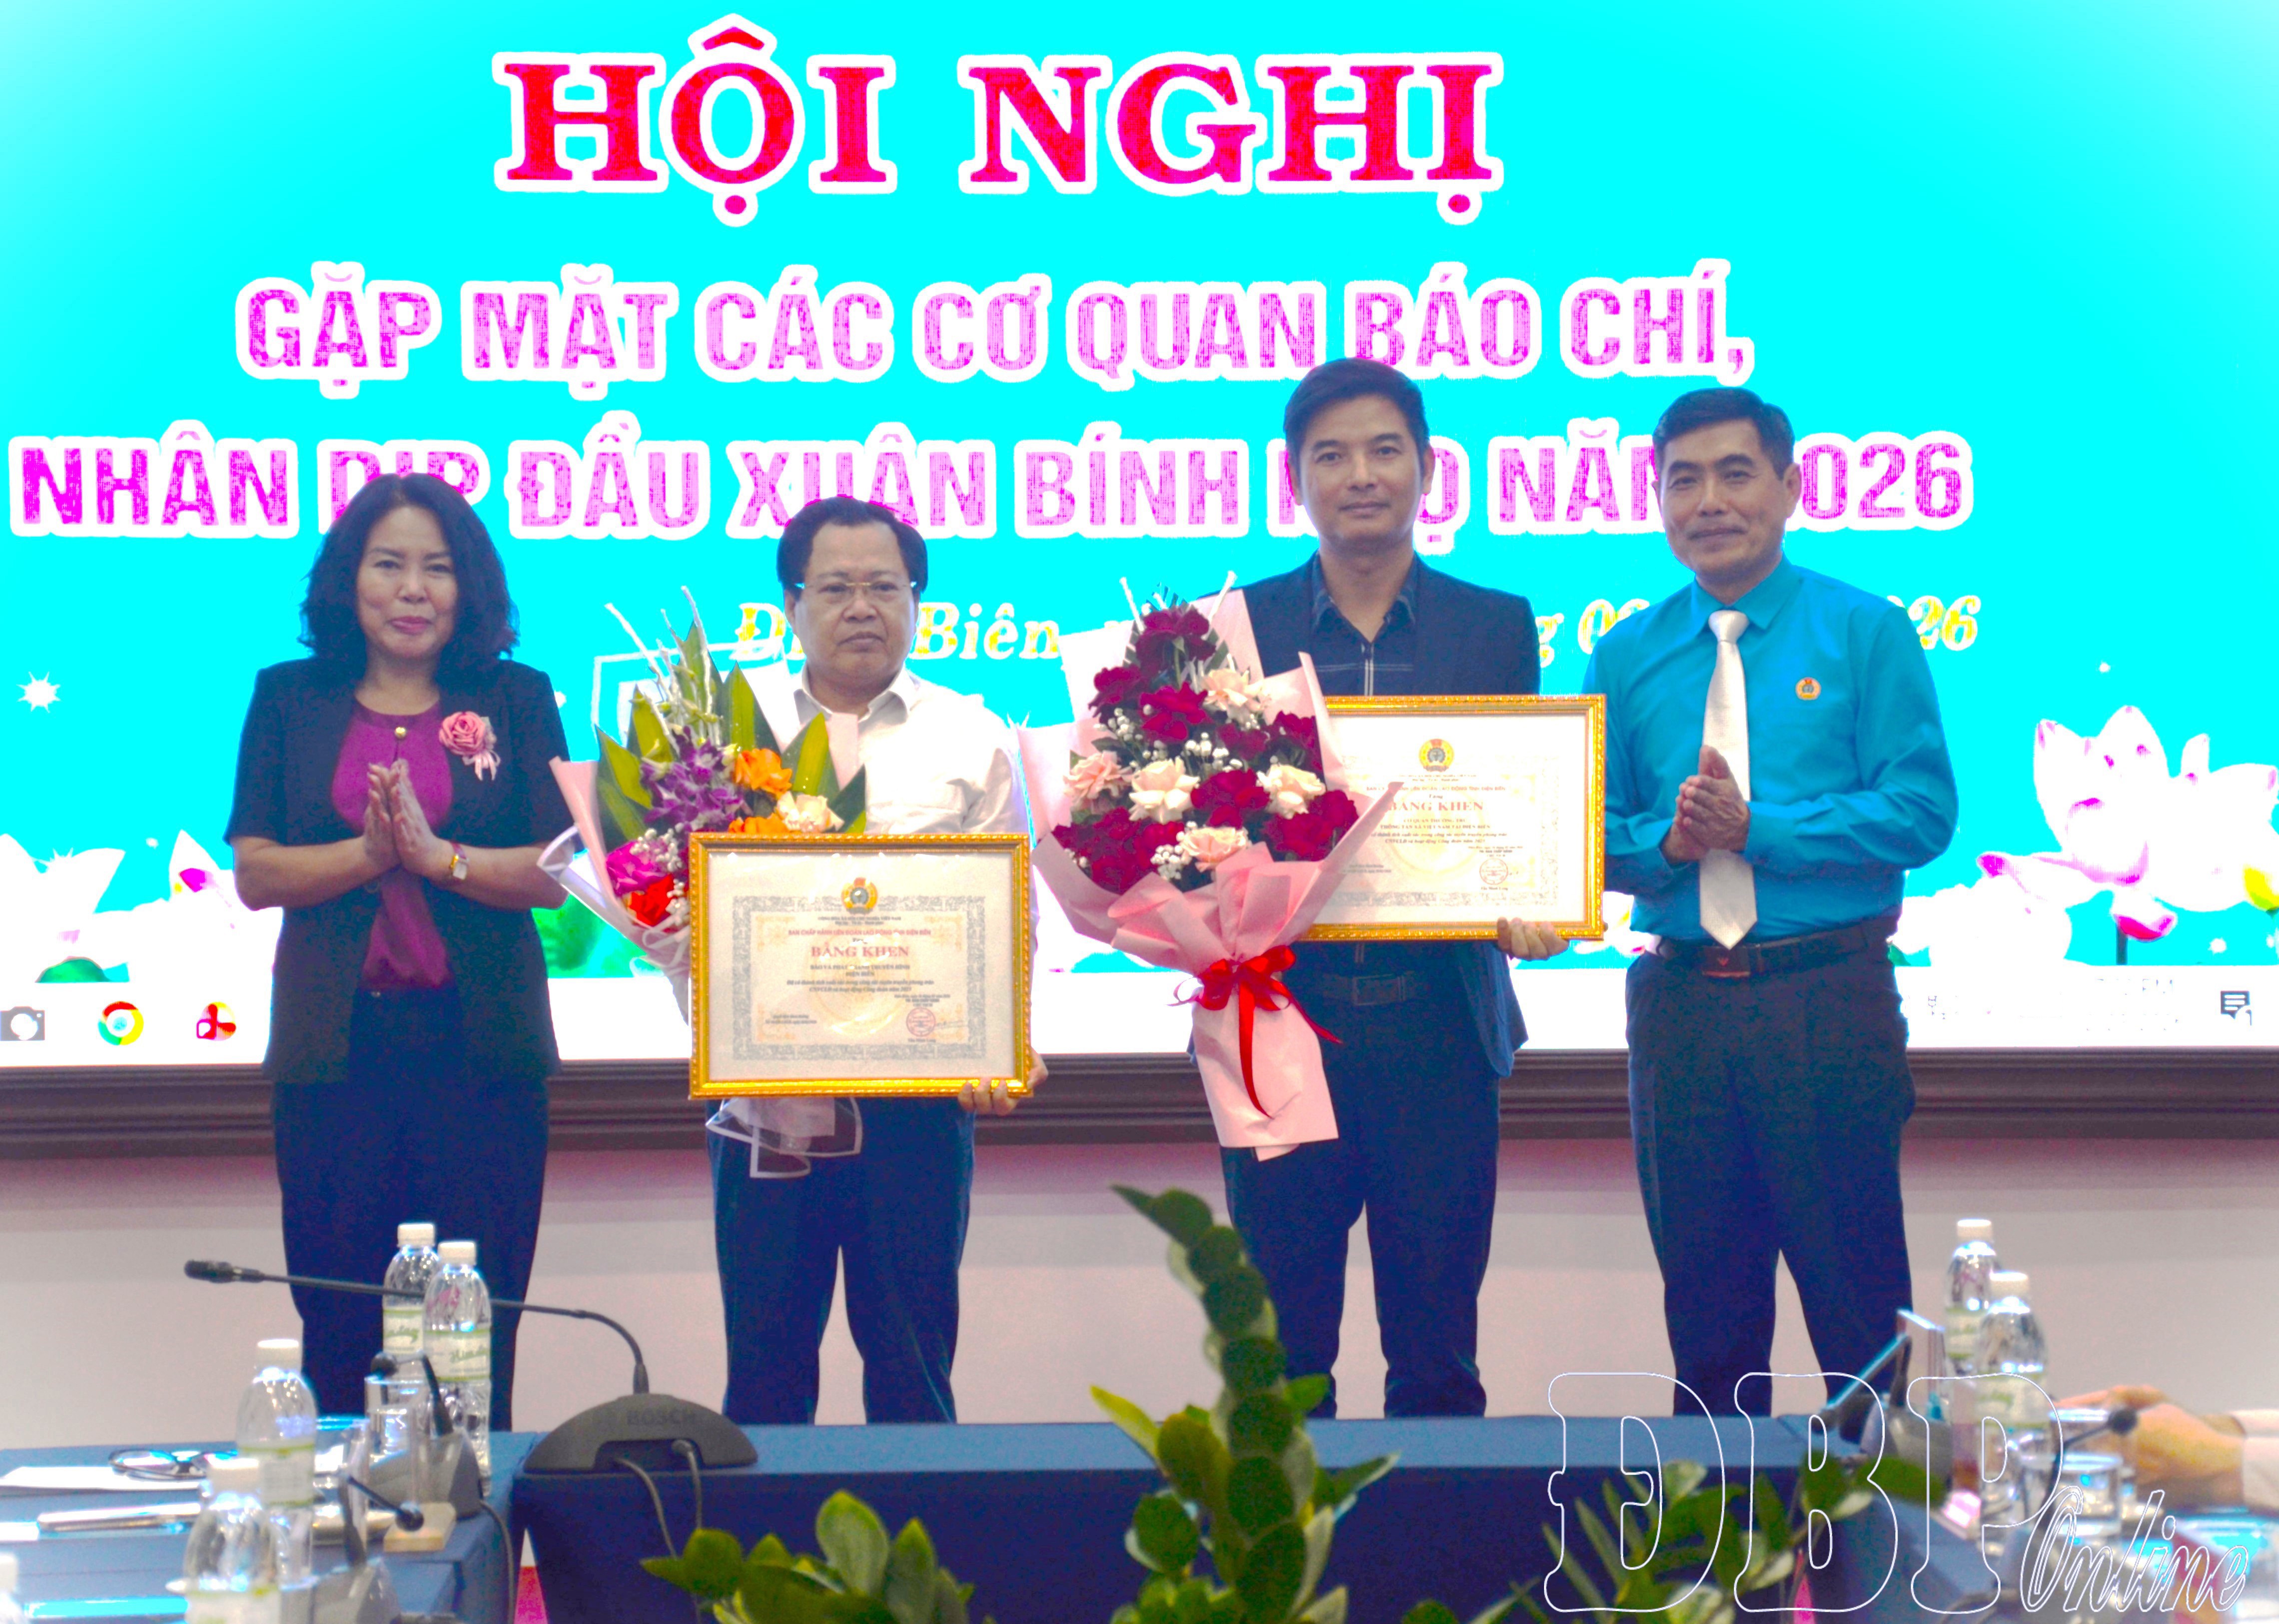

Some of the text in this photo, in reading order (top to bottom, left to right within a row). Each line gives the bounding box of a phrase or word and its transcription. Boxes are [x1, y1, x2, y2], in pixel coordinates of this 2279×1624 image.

[499, 21, 1497, 219] HỘI NGHỊ
[243, 266, 1747, 393] GẶP MẶT CÁC CƠ QUAN BÁO CHÍ,
[17, 426, 292, 530] NHÂN
[513, 418, 703, 532] ĐẦU
[736, 429, 989, 531] XUÂN
[1022, 429, 1242, 530] BÍNH
[1439, 802, 1483, 811] KHEN
[862, 946, 909, 957] KHEN
